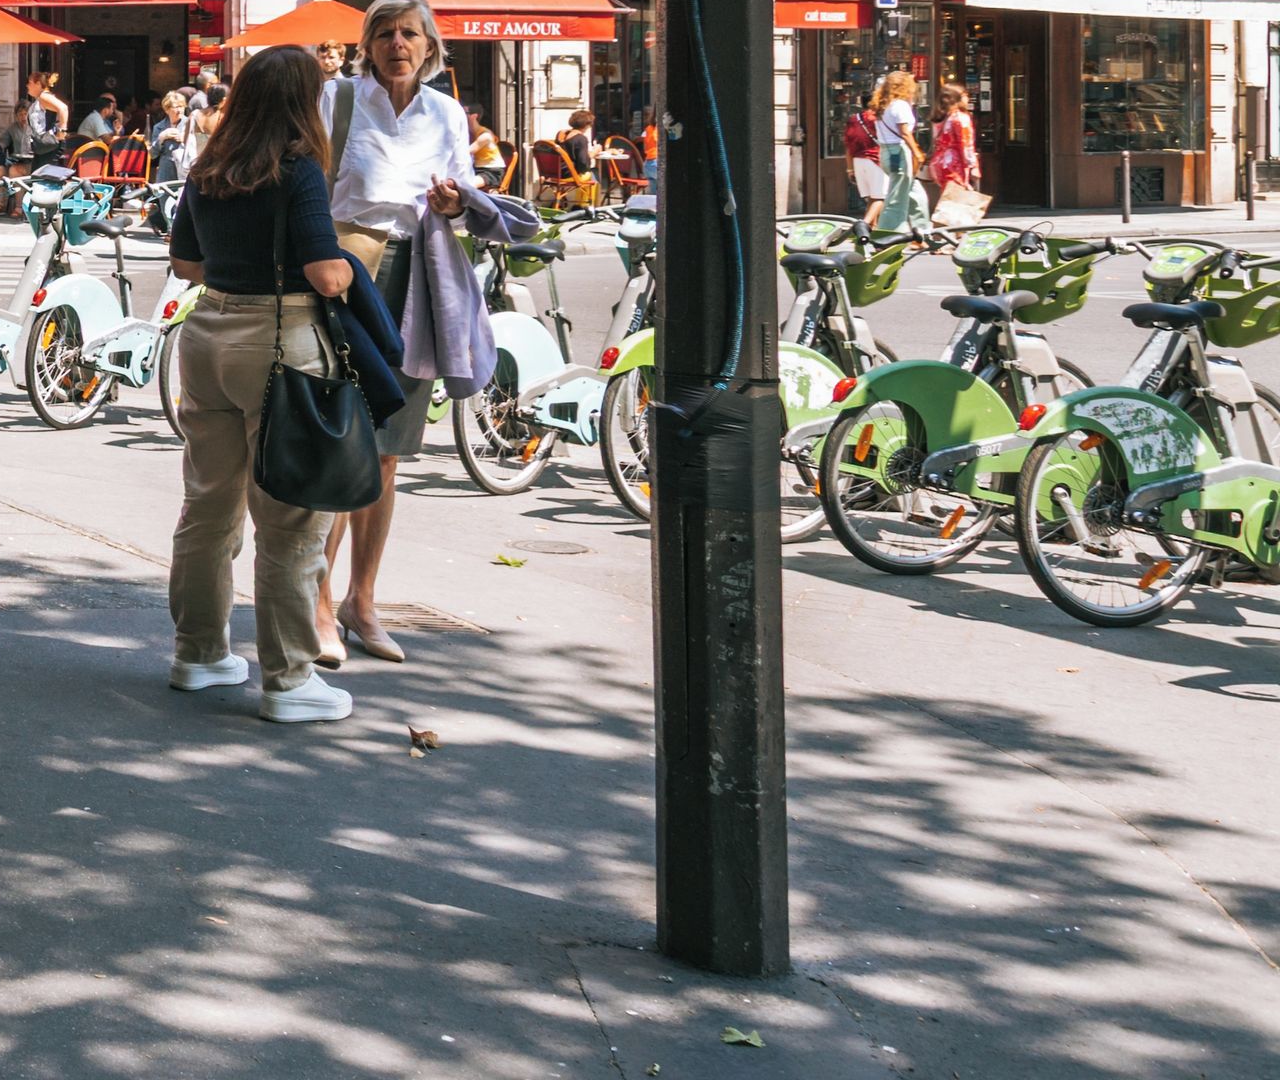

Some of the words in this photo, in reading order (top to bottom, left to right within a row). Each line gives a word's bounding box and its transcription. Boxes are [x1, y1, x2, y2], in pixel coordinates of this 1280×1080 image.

[464, 21, 481, 35] LE
[483, 22, 501, 36] ST
[503, 22, 562, 36] AMOUR
